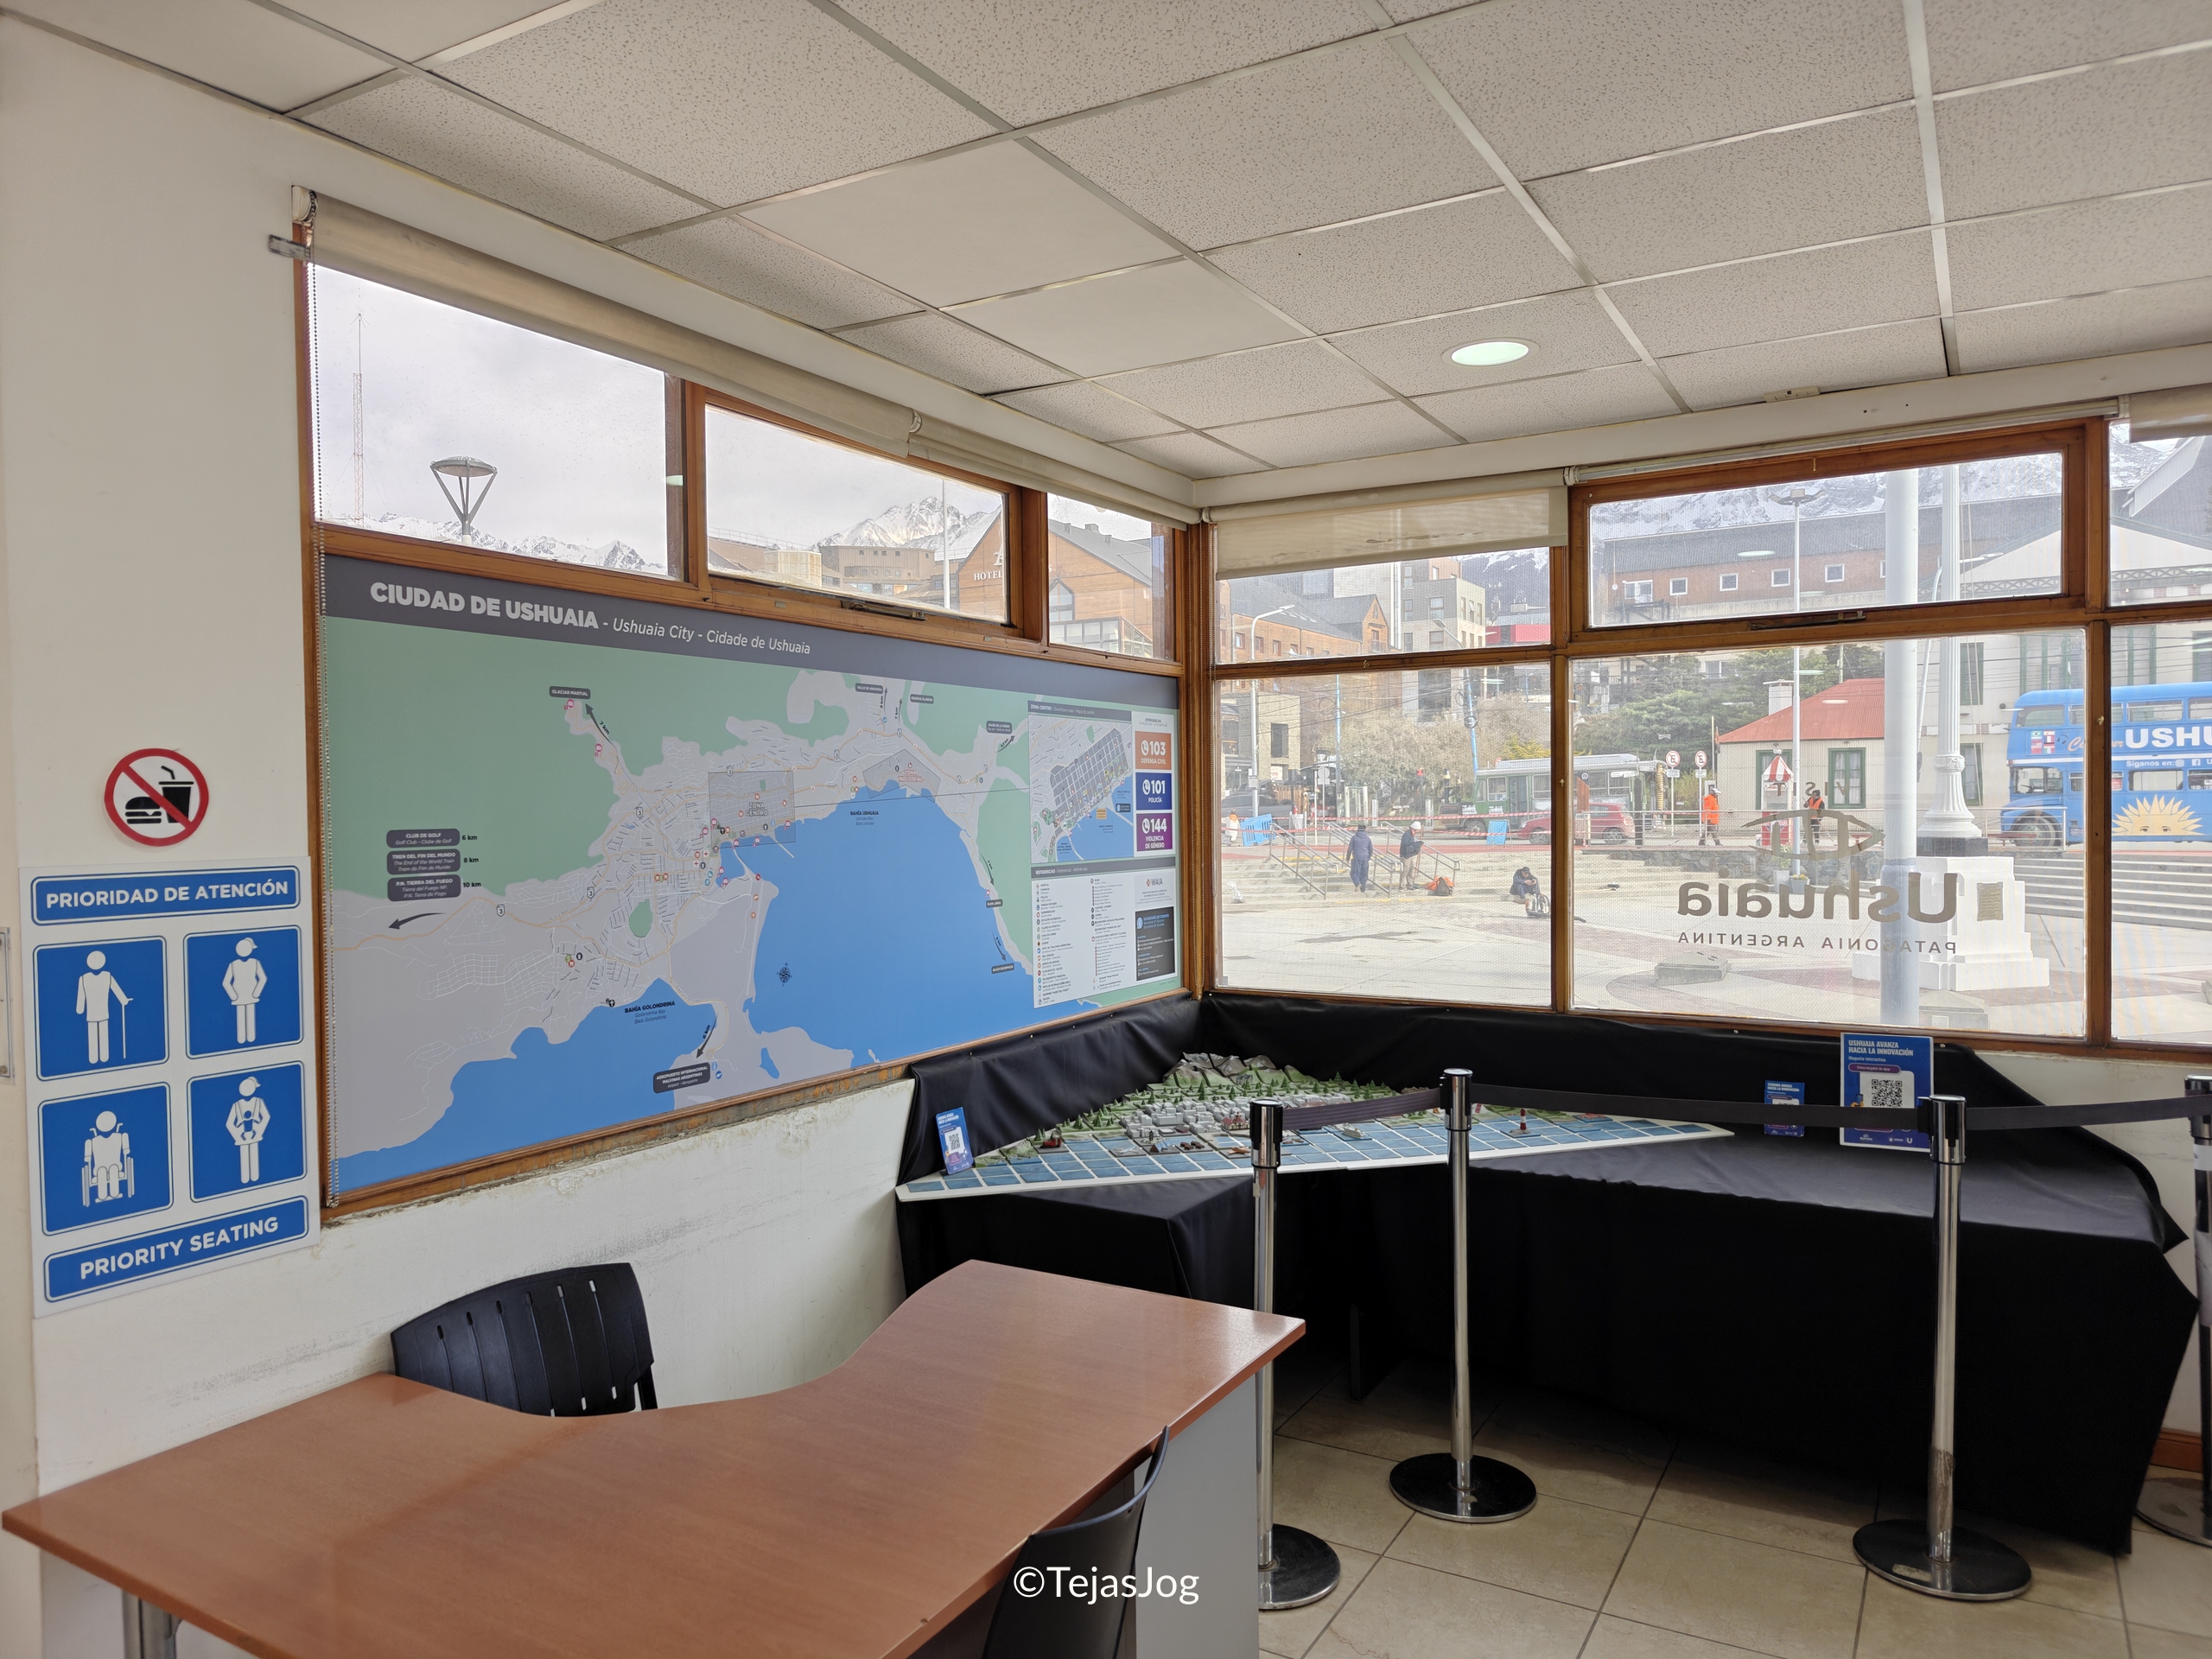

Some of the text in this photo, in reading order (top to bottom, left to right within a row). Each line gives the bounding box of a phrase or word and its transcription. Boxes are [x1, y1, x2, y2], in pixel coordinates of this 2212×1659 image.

[974, 570, 1002, 581] HOTEL
[370, 582, 465, 612] CIUDAD
[470, 594, 501, 617] DE
[505, 600, 600, 629] USHUAIA
[613, 617, 665, 638] Ushuaia
[669, 625, 695, 643] City
[706, 629, 748, 648] Cidade
[751, 636, 766, 650] de
[768, 638, 810, 655] Ushuaia
[601, 724, 610, 735] km
[1149, 741, 1166, 756] 103
[1151, 779, 1165, 795] 101
[1150, 817, 1166, 833] 144
[47, 879, 289, 909] PRIORIDAD DE ATENCIÓN
[624, 1001, 676, 1013] BAHÍA GOLONDRINA
[634, 1009, 657, 1018] Golondrina
[644, 1014, 667, 1023] Golondrina
[703, 1024, 710, 1035] km
[1876, 1040, 1899, 1049] AVANZA
[1877, 1047, 1913, 1056] INNOVACIÓN
[656, 1065, 709, 1080] AEROPUERTO INTERNACIONAL
[681, 1072, 703, 1081] ARGENTINAS
[80, 1217, 278, 1280] PRIORITY SEATING
